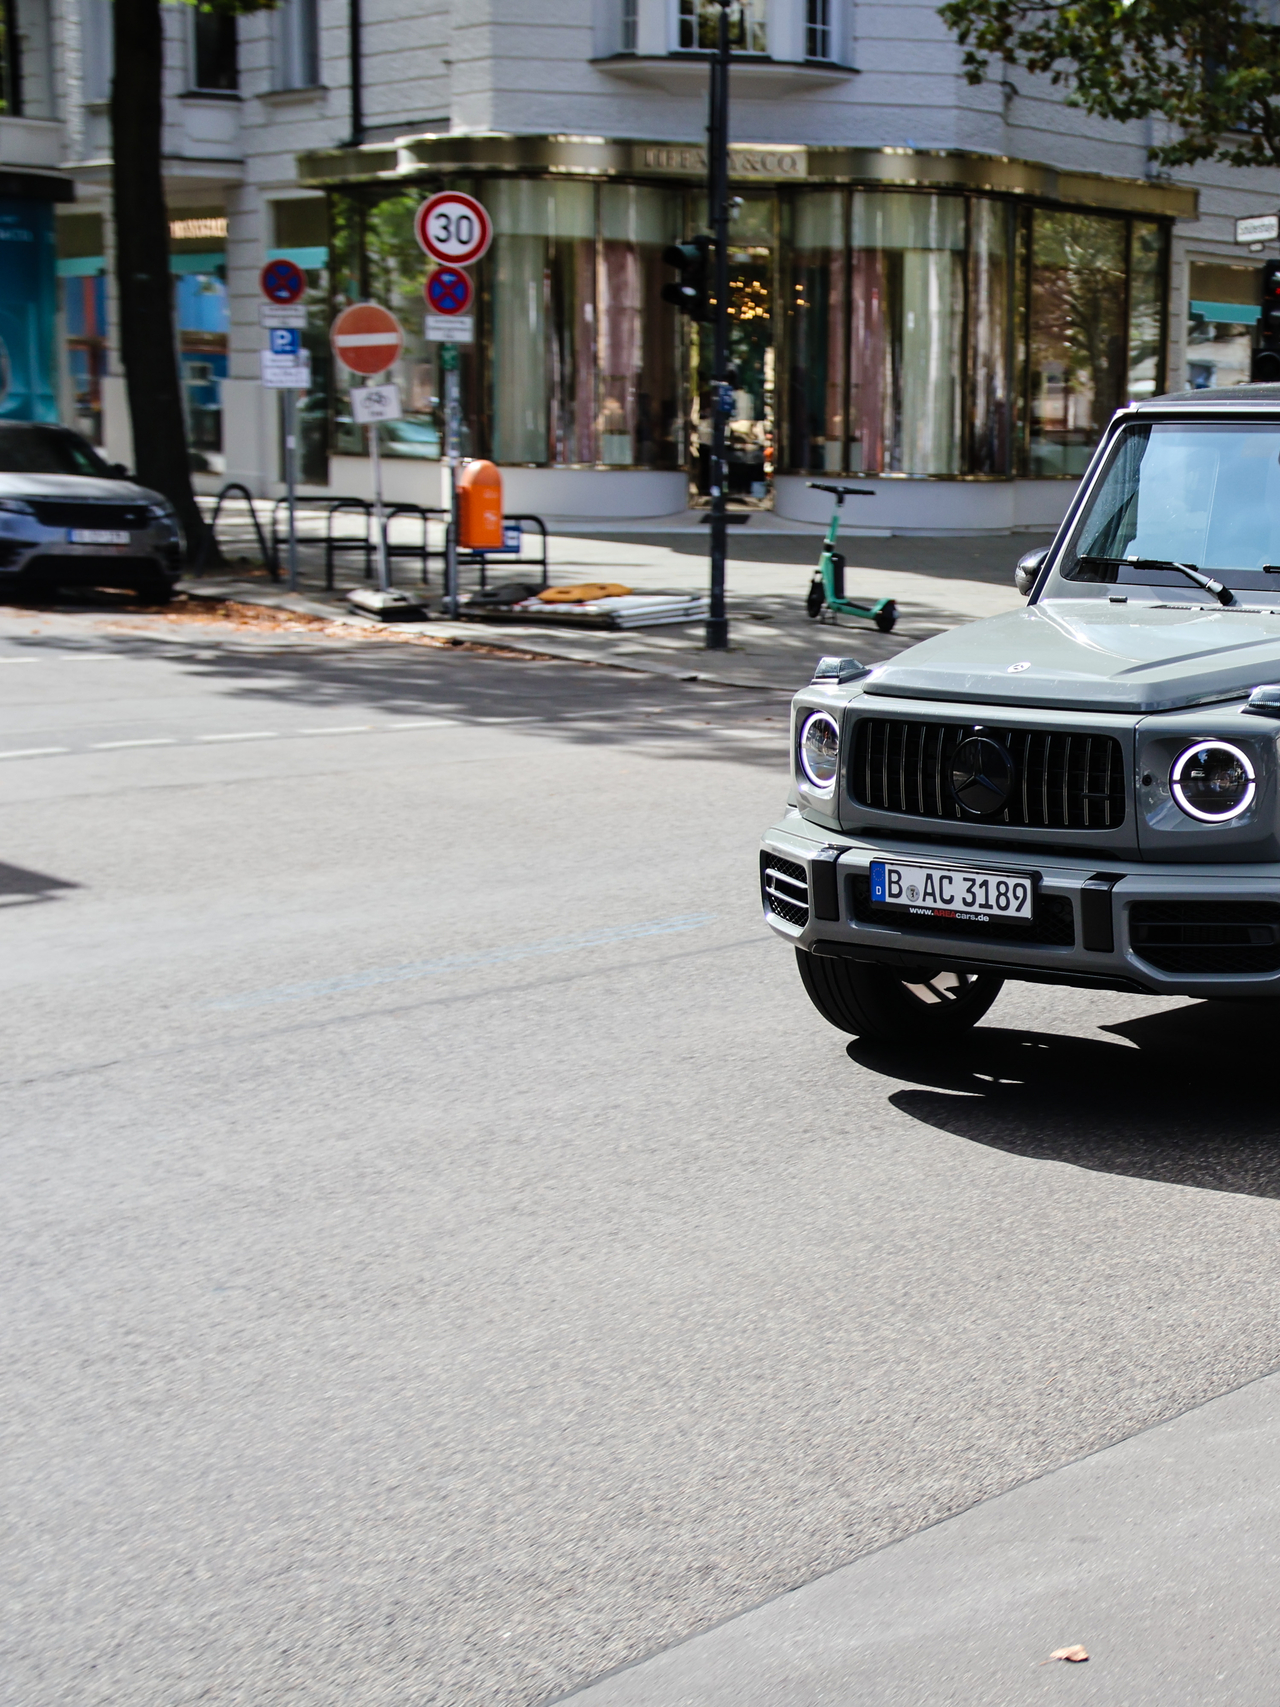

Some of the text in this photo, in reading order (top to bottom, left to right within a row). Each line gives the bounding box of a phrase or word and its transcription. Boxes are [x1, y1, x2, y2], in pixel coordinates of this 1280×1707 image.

[434, 212, 474, 245] 30
[273, 329, 292, 351] P
[875, 885, 882, 895] D
[887, 868, 1028, 913] B AC 3189
[909, 906, 990, 922] www.AREAcars.de
